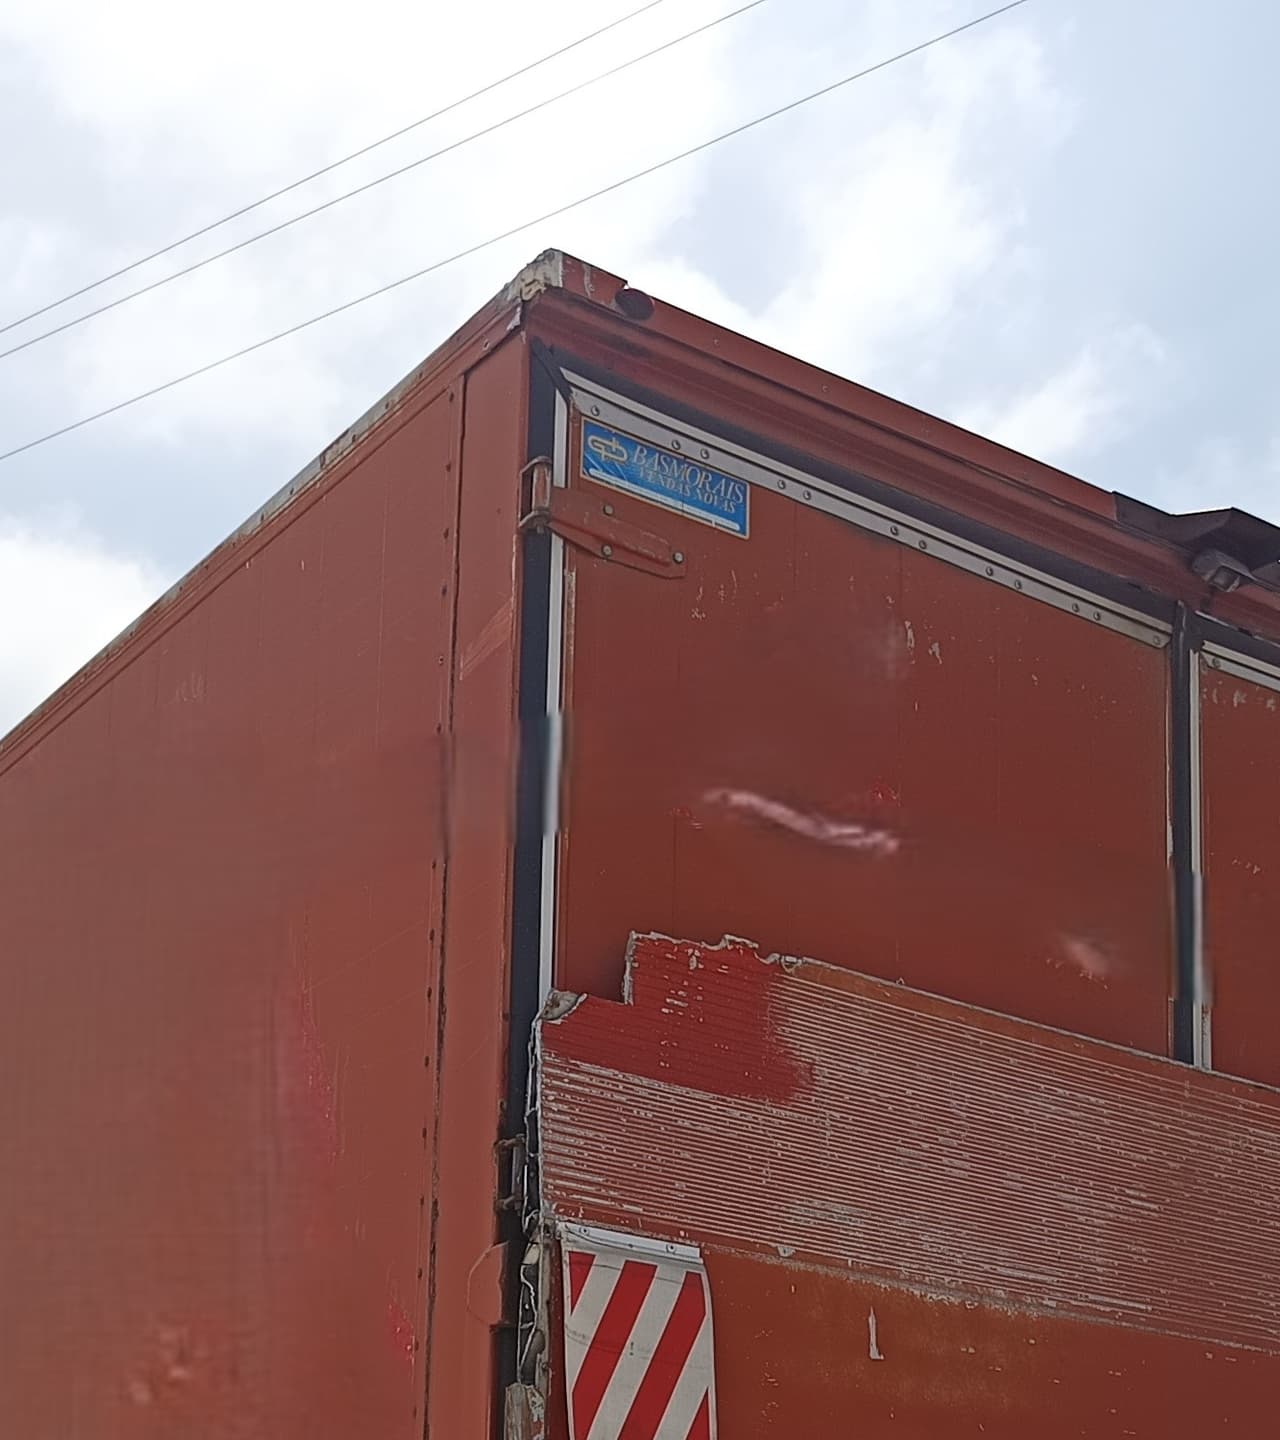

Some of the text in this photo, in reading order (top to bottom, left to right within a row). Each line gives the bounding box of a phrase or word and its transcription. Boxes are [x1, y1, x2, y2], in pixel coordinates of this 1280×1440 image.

[633, 445, 744, 504] BASMORAIS
[639, 466, 736, 514] VENDAS NOVAS
